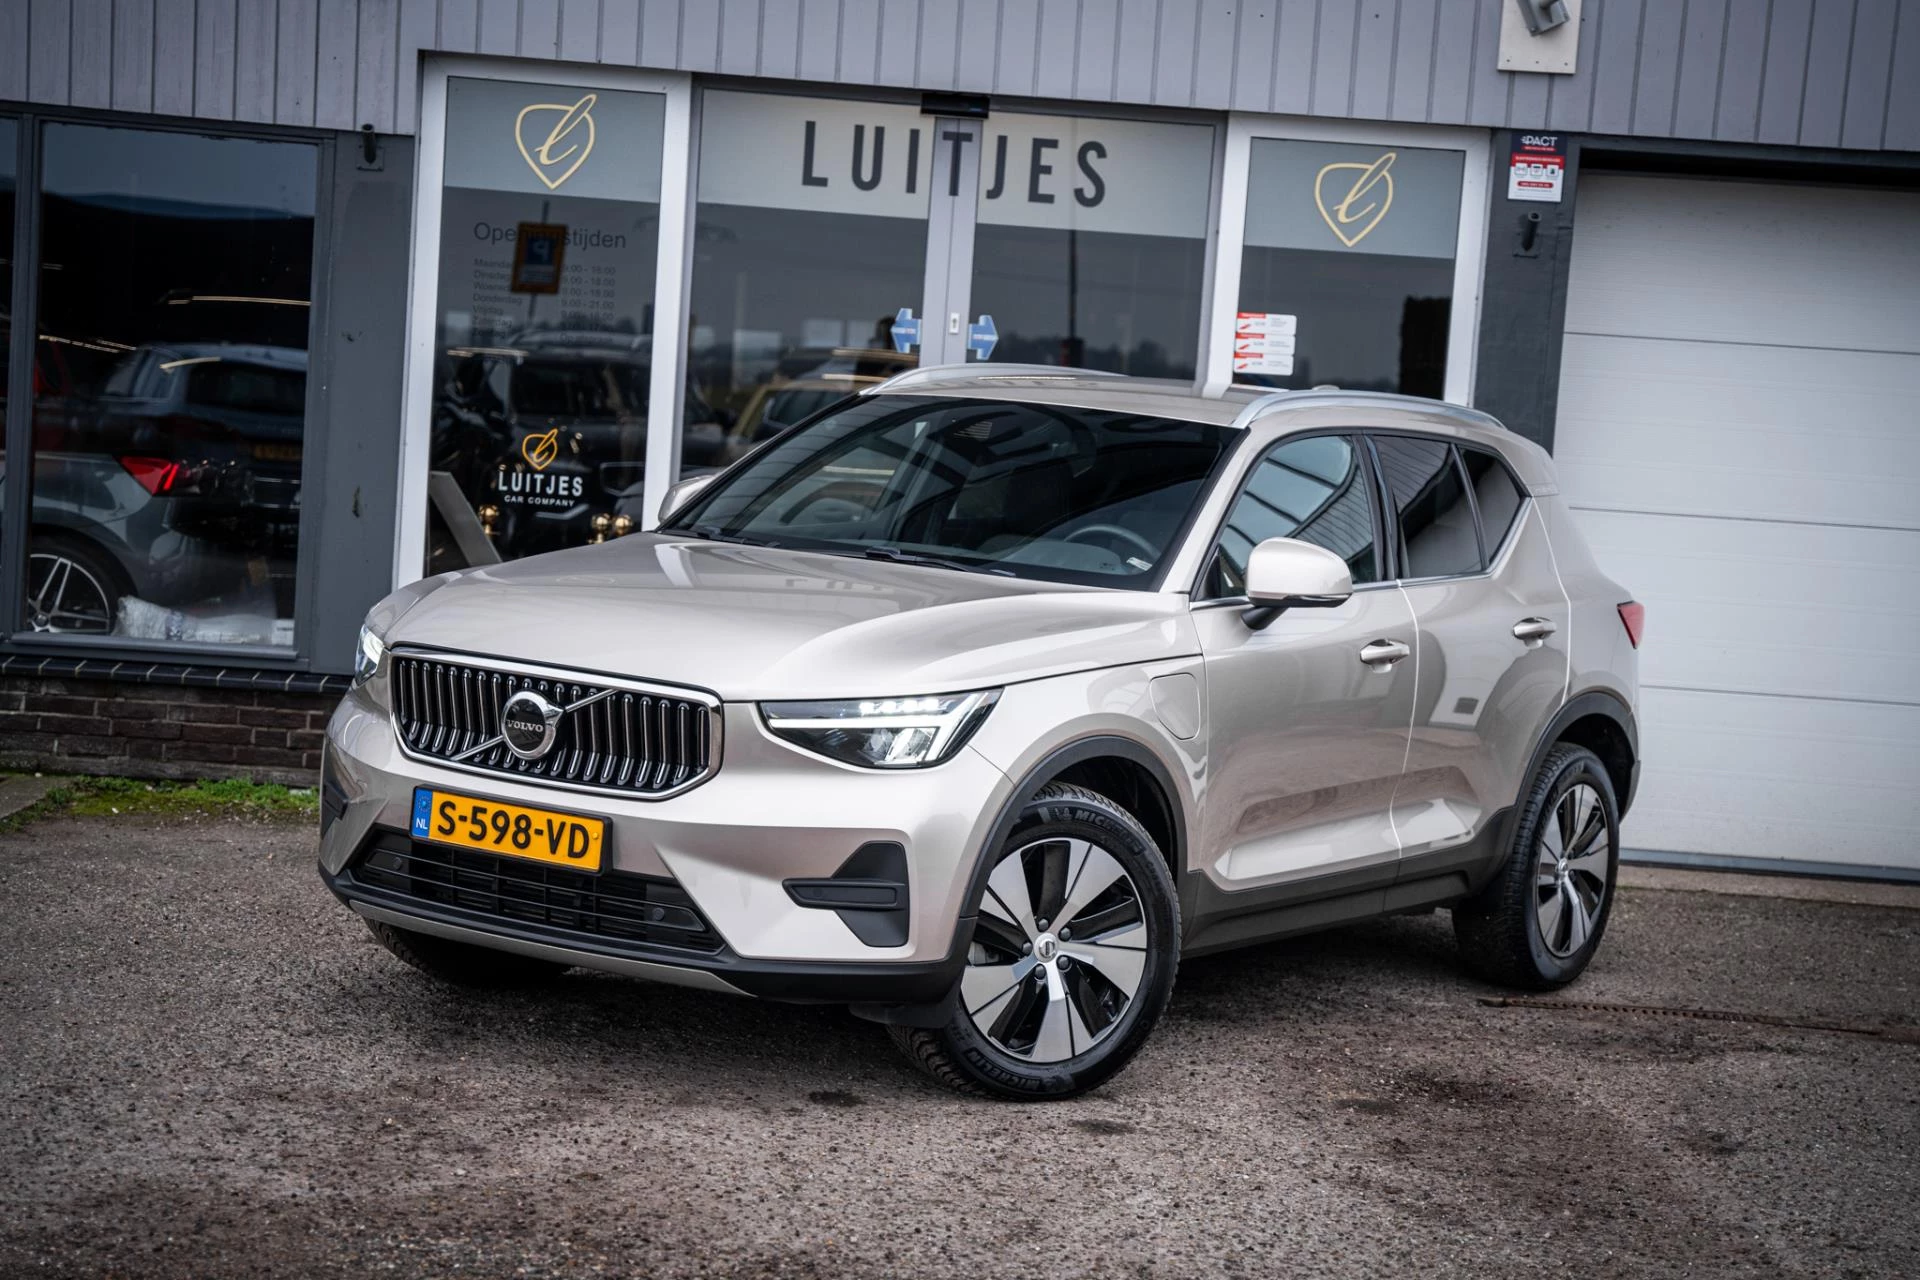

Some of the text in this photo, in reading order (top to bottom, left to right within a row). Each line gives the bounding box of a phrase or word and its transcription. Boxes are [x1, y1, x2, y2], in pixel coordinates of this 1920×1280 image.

[802, 120, 1108, 208] LUITJES
[474, 222, 626, 251] Opestijden
[498, 471, 583, 497] LUITJES
[504, 495, 575, 507] CAR COMPANY
[507, 720, 544, 732] VOLVO
[415, 818, 428, 830] NL
[437, 801, 590, 858] S-598-VD
